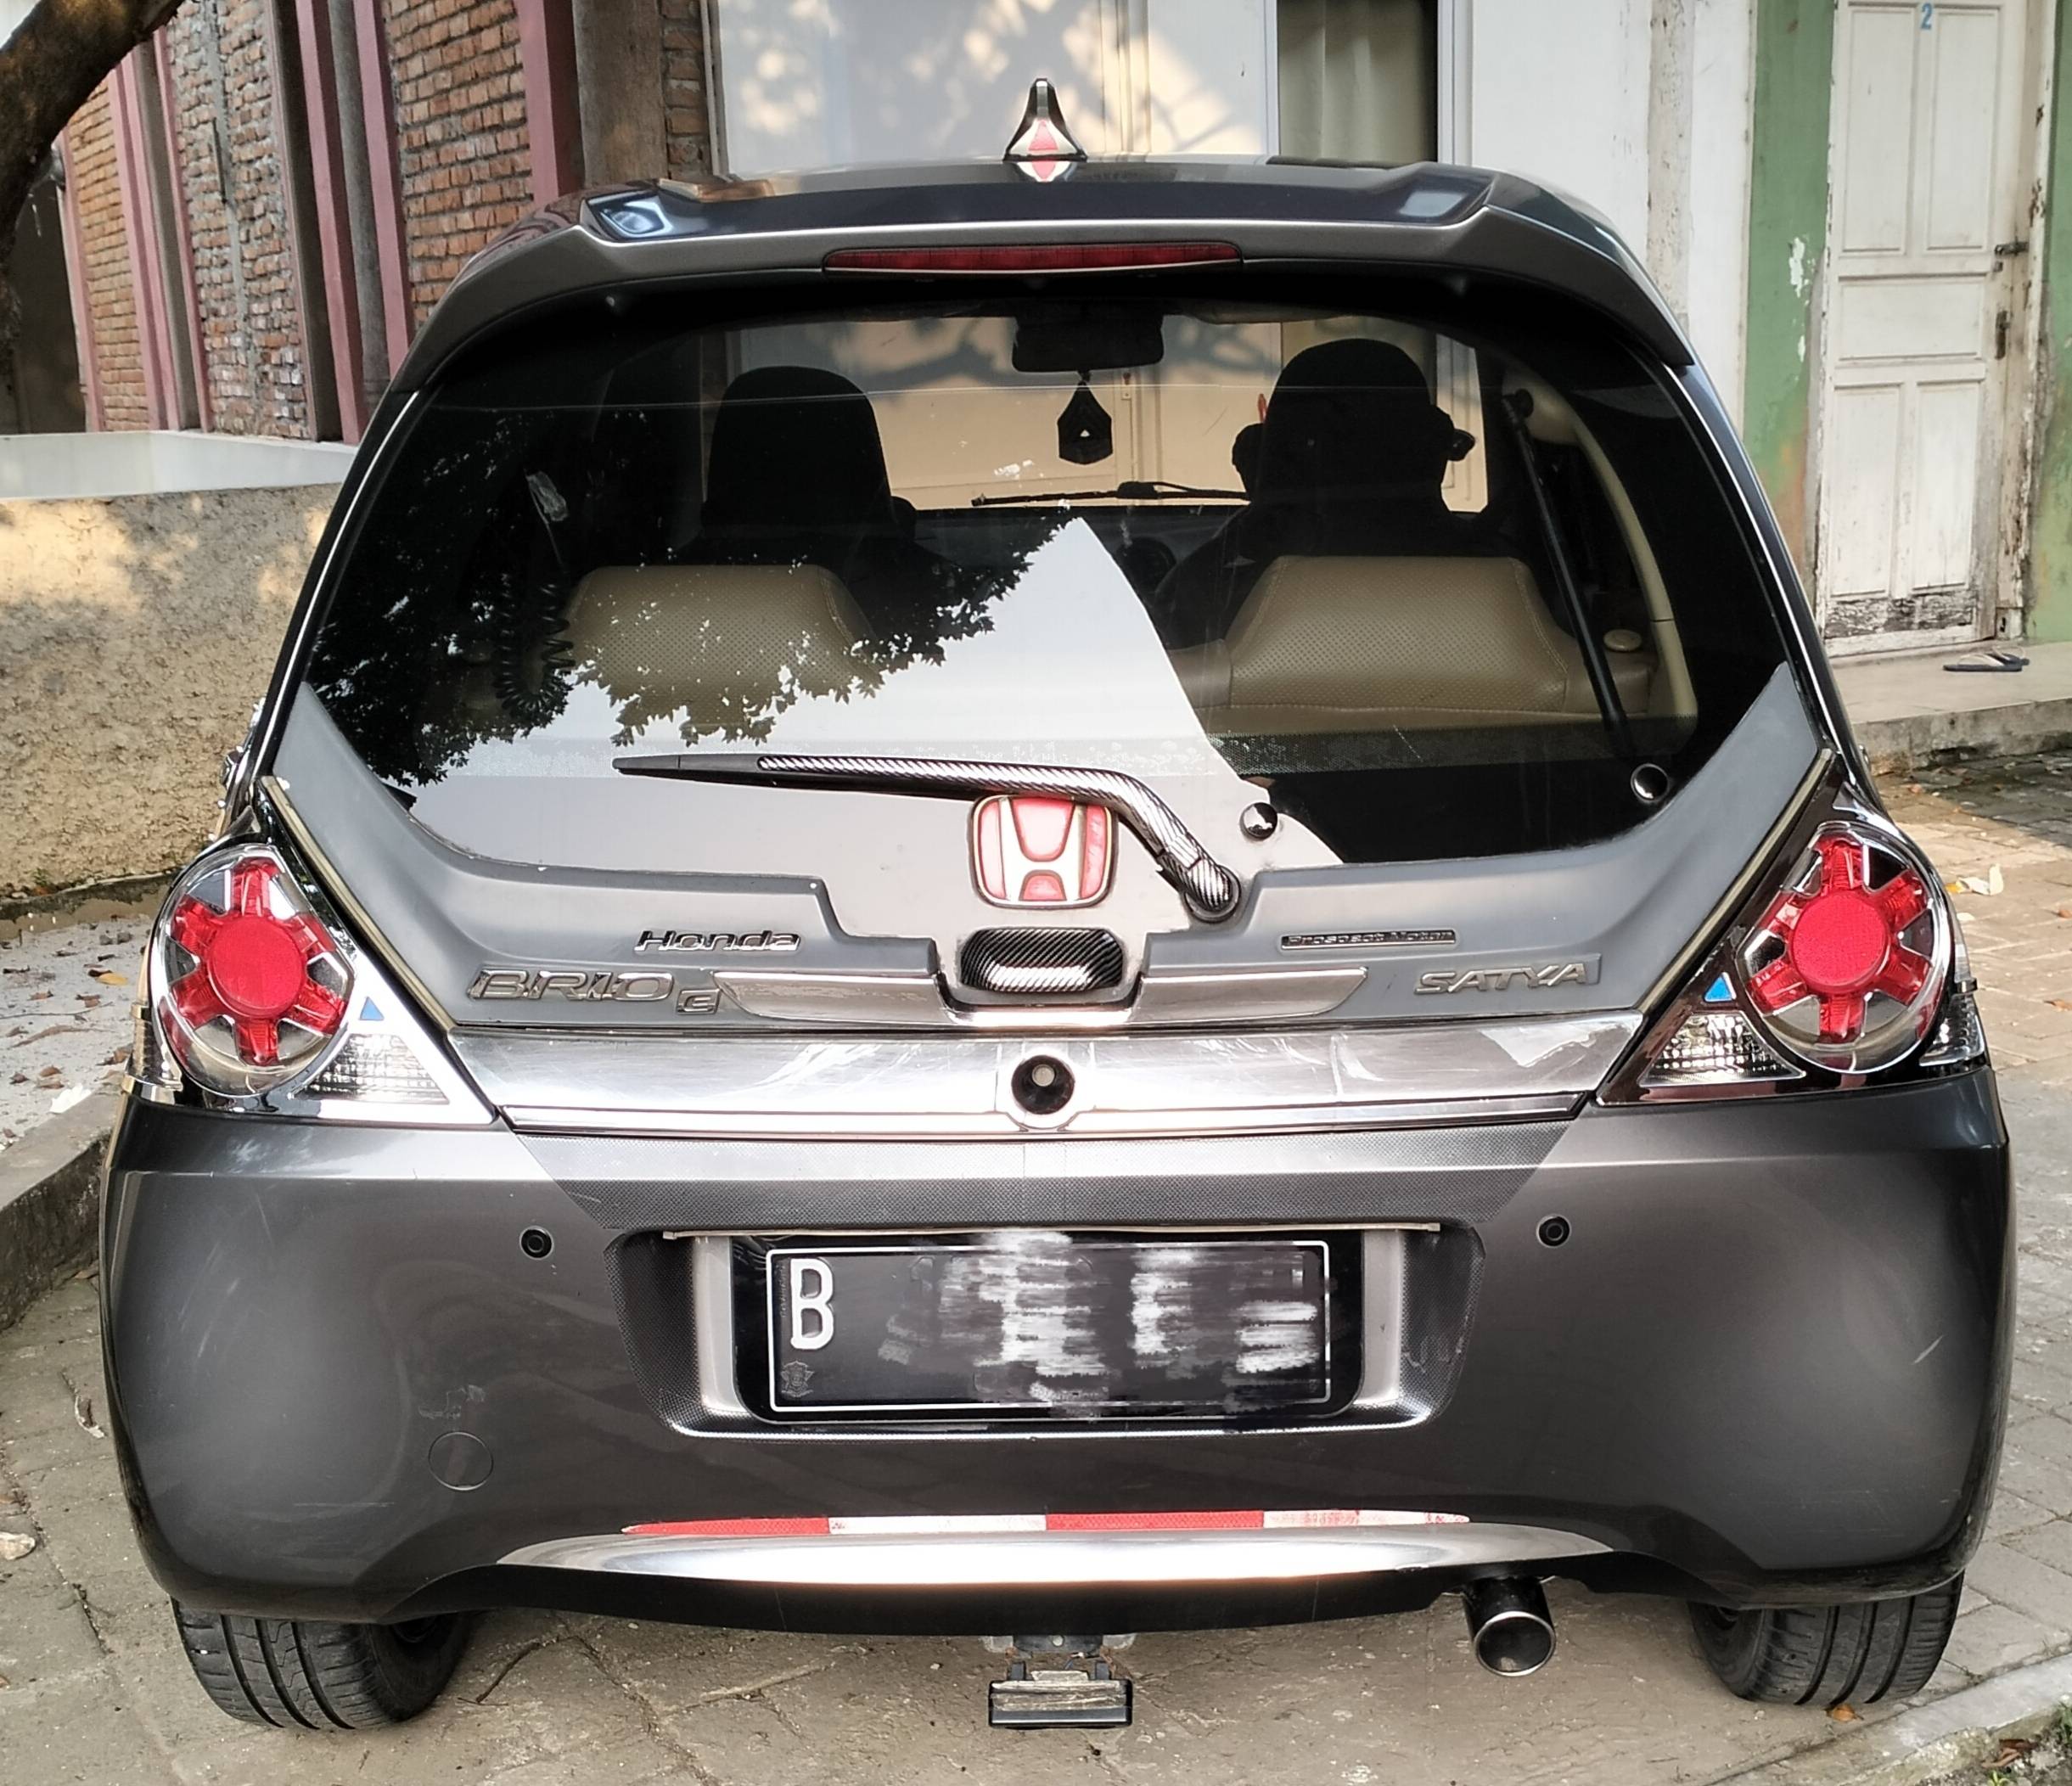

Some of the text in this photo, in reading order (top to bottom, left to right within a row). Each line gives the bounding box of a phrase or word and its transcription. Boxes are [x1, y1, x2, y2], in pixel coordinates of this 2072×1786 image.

[1920, 3, 1933, 31] 2
[634, 930, 801, 952] Honda
[467, 968, 675, 1001] BRIO
[1414, 963, 1586, 995] SATYA
[790, 1258, 834, 1350] B
